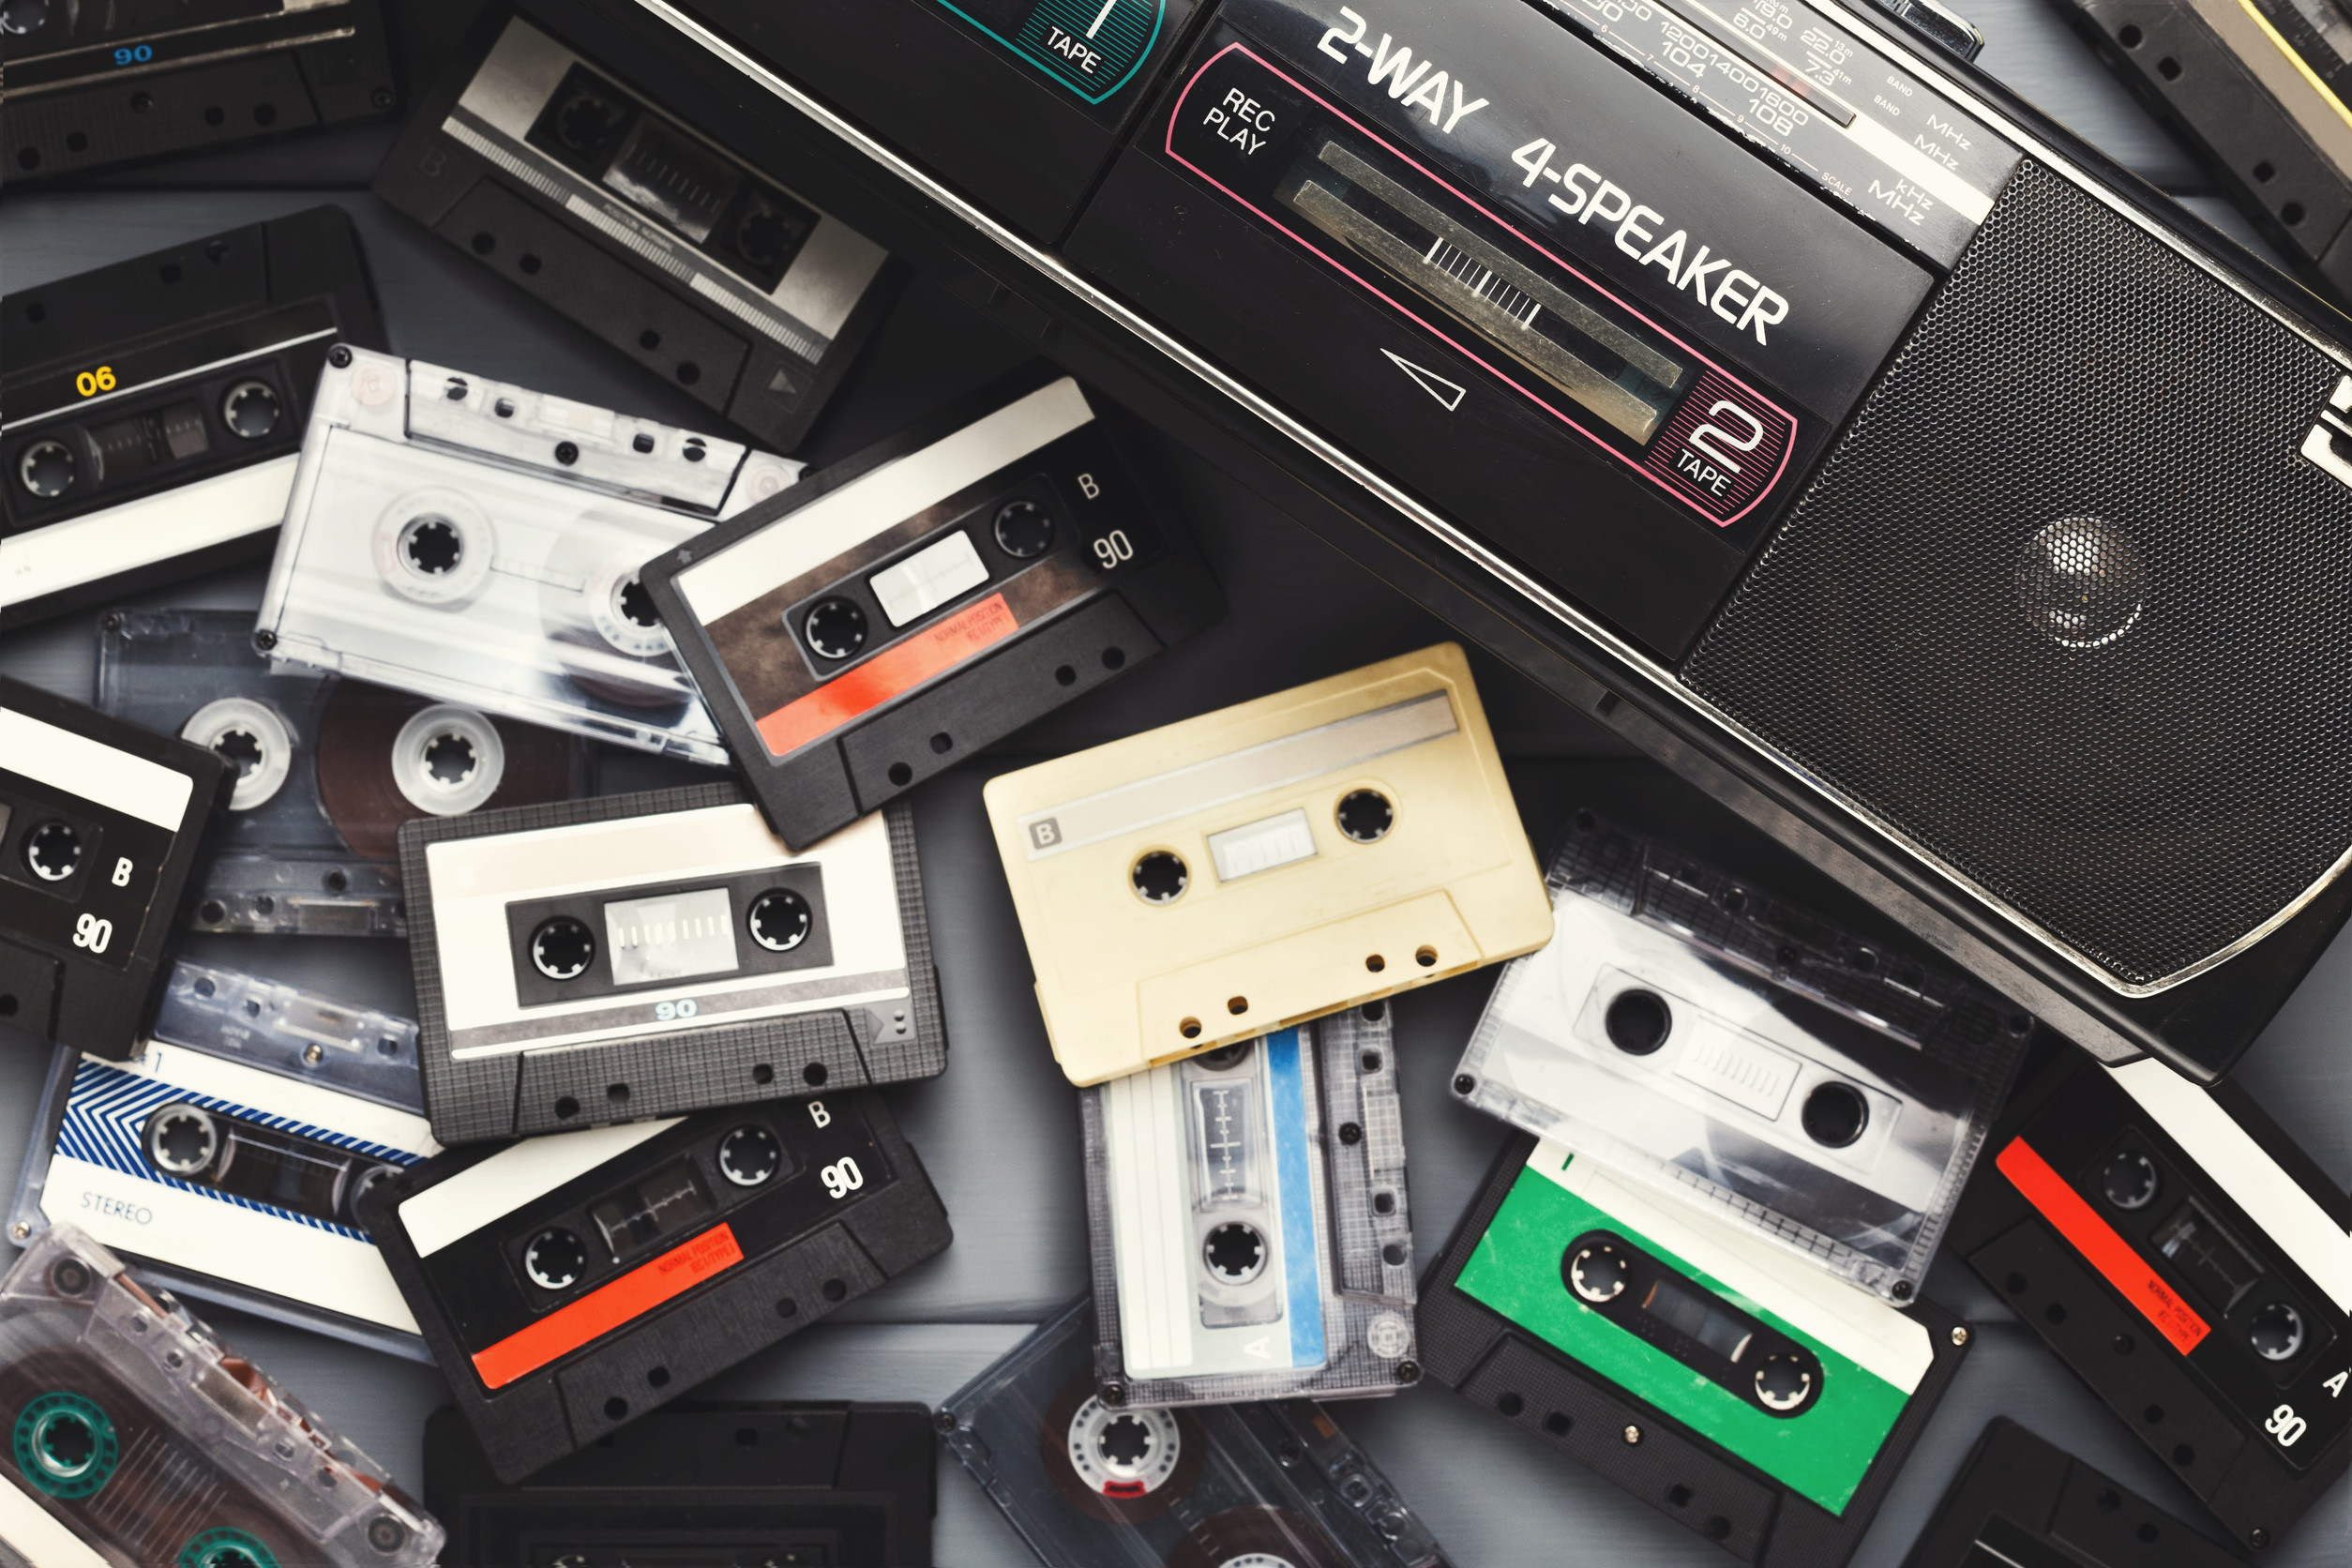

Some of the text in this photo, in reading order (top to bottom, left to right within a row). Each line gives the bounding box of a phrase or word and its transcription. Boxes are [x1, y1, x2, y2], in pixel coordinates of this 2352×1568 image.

[113, 44, 153, 66] 90
[1048, 25, 1102, 74] TAPE
[1733, 12, 1835, 86] 6.0 7.3
[1800, 29, 1847, 66] 22.0
[1660, 21, 1710, 60] 1200
[1709, 53, 1759, 93] 1400
[1759, 87, 1809, 127] 1600
[1662, 41, 1794, 137] 104 108
[1887, 75, 1914, 98] BAND
[1222, 87, 1275, 132] REC
[1600, 23, 1853, 197] 6 7 8 9 10 SCALE
[1874, 95, 1901, 116] BAND
[1202, 107, 1267, 156] PLAY
[1926, 113, 1972, 151] MHz
[1913, 134, 1960, 171] MHz
[1317, 6, 1789, 346] 2-WAY 4-SPEAKER
[1896, 178, 1935, 211] kHz
[1867, 179, 1926, 226] MHz
[1689, 400, 1764, 474] 2
[1078, 473, 1100, 500] B
[1677, 448, 1732, 497] TAPE
[1093, 529, 1134, 569] 90
[1035, 822, 1056, 845] B
[112, 856, 133, 887] B
[72, 912, 113, 955] 90
[655, 998, 698, 1022] 90
[807, 1100, 831, 1129] B
[821, 1156, 864, 1199] 90
[81, 1190, 153, 1226] STEREO
[1243, 1334, 1272, 1361] A
[2322, 1370, 2349, 1398] A
[2265, 1404, 2307, 1447] 90
